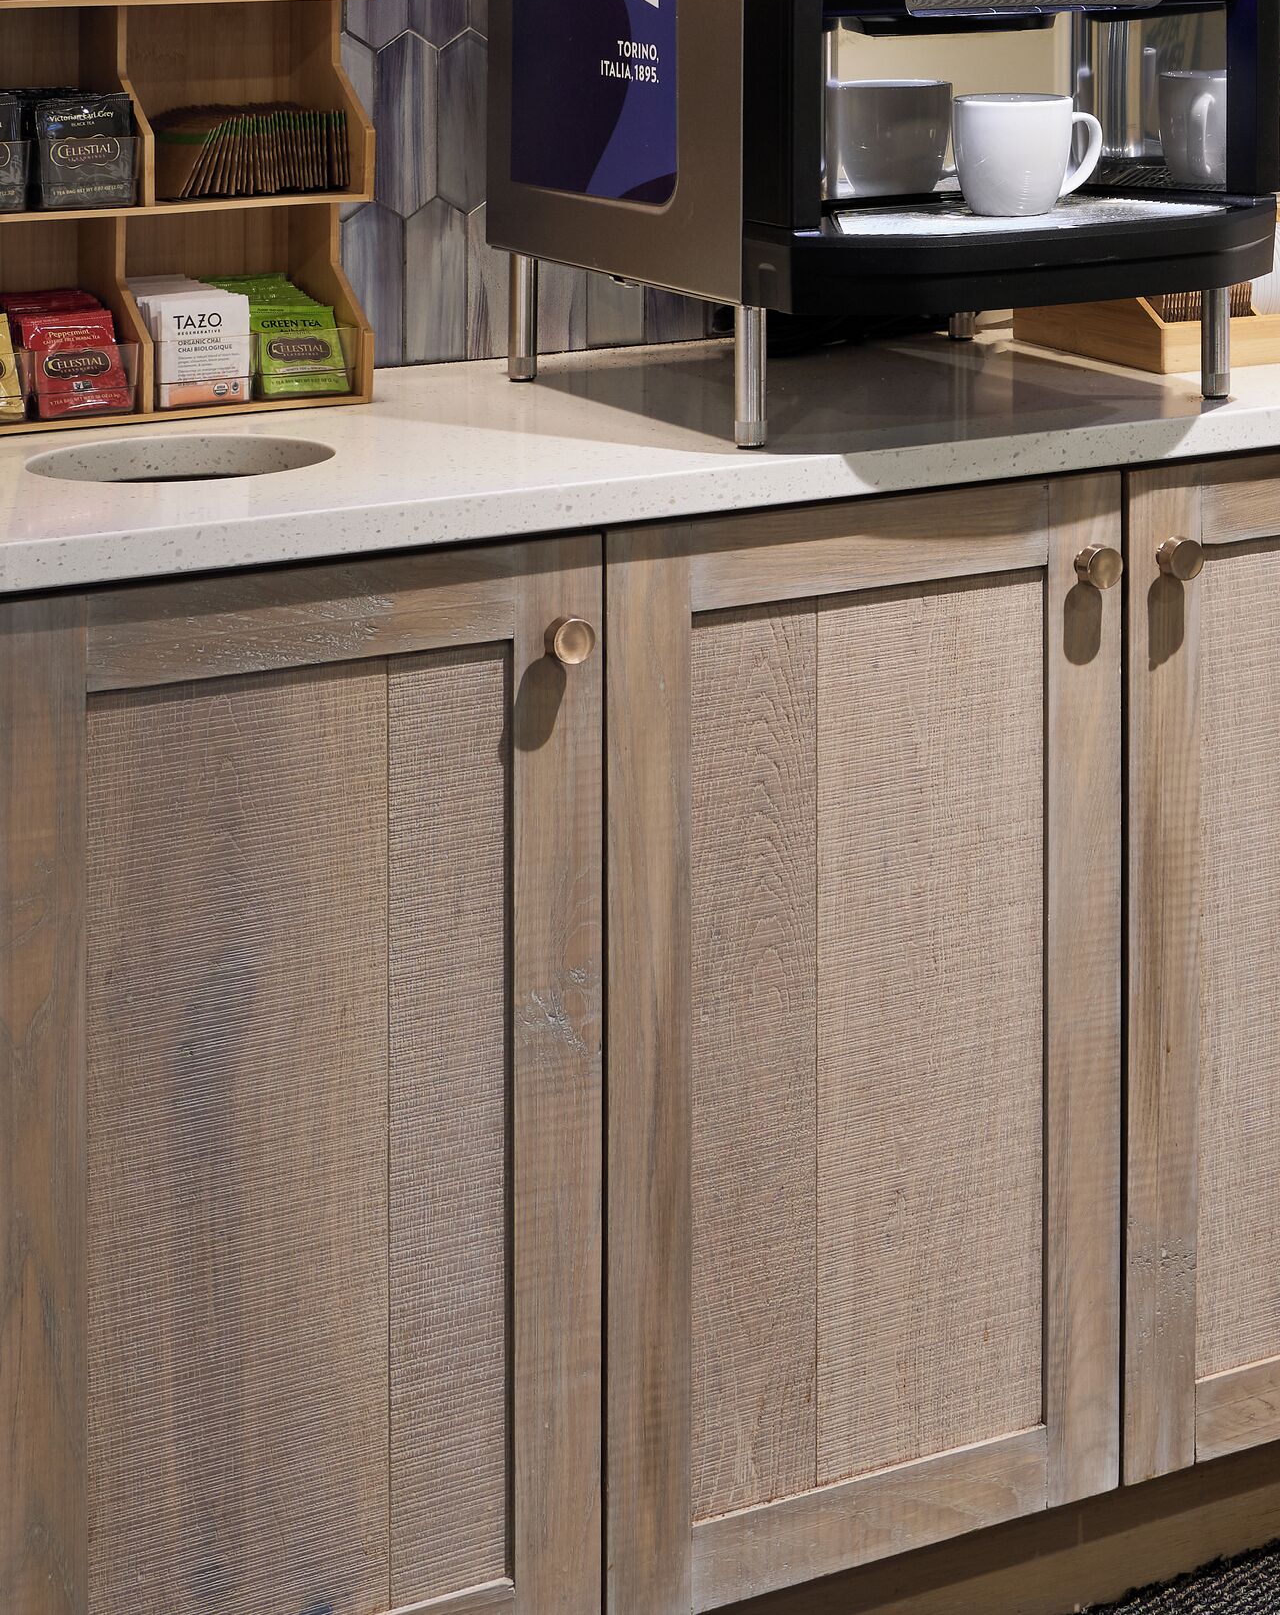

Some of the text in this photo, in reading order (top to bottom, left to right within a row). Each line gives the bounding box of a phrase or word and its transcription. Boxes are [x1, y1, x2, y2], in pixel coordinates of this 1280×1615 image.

[617, 40, 659, 64] TORINO,
[98, 110, 114, 118] Grey
[261, 319, 322, 328] GREEN TEA
[48, 328, 90, 339] Peppermint
[178, 338, 206, 346] ORGANIC
[194, 344, 233, 352] BIOLOGIQUE
